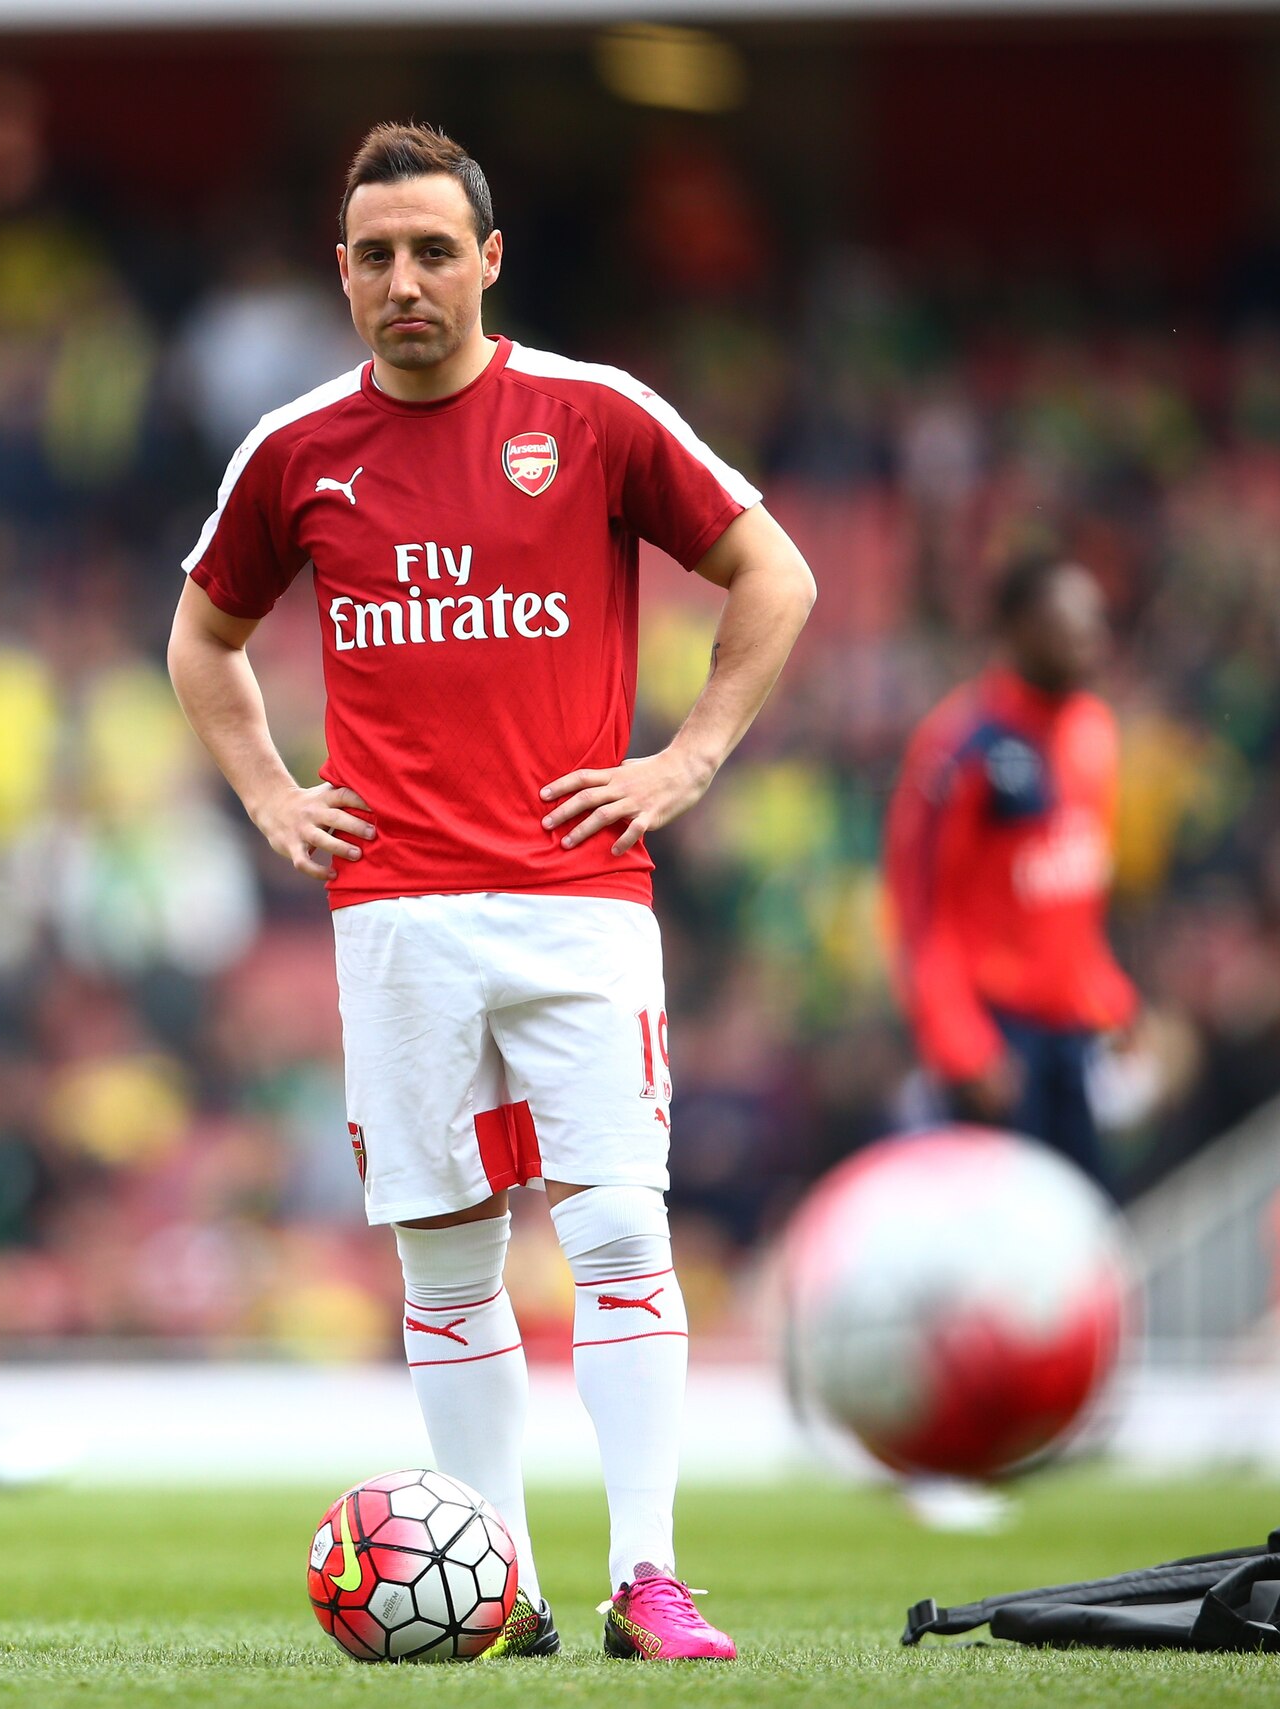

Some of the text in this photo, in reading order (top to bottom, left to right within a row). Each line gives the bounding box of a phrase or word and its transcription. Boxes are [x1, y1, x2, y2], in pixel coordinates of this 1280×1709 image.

[510, 442, 550, 455] Arsenal
[393, 541, 473, 586] Fly
[329, 584, 570, 651] Emirates
[382, 1590, 400, 1619] ORDEM
